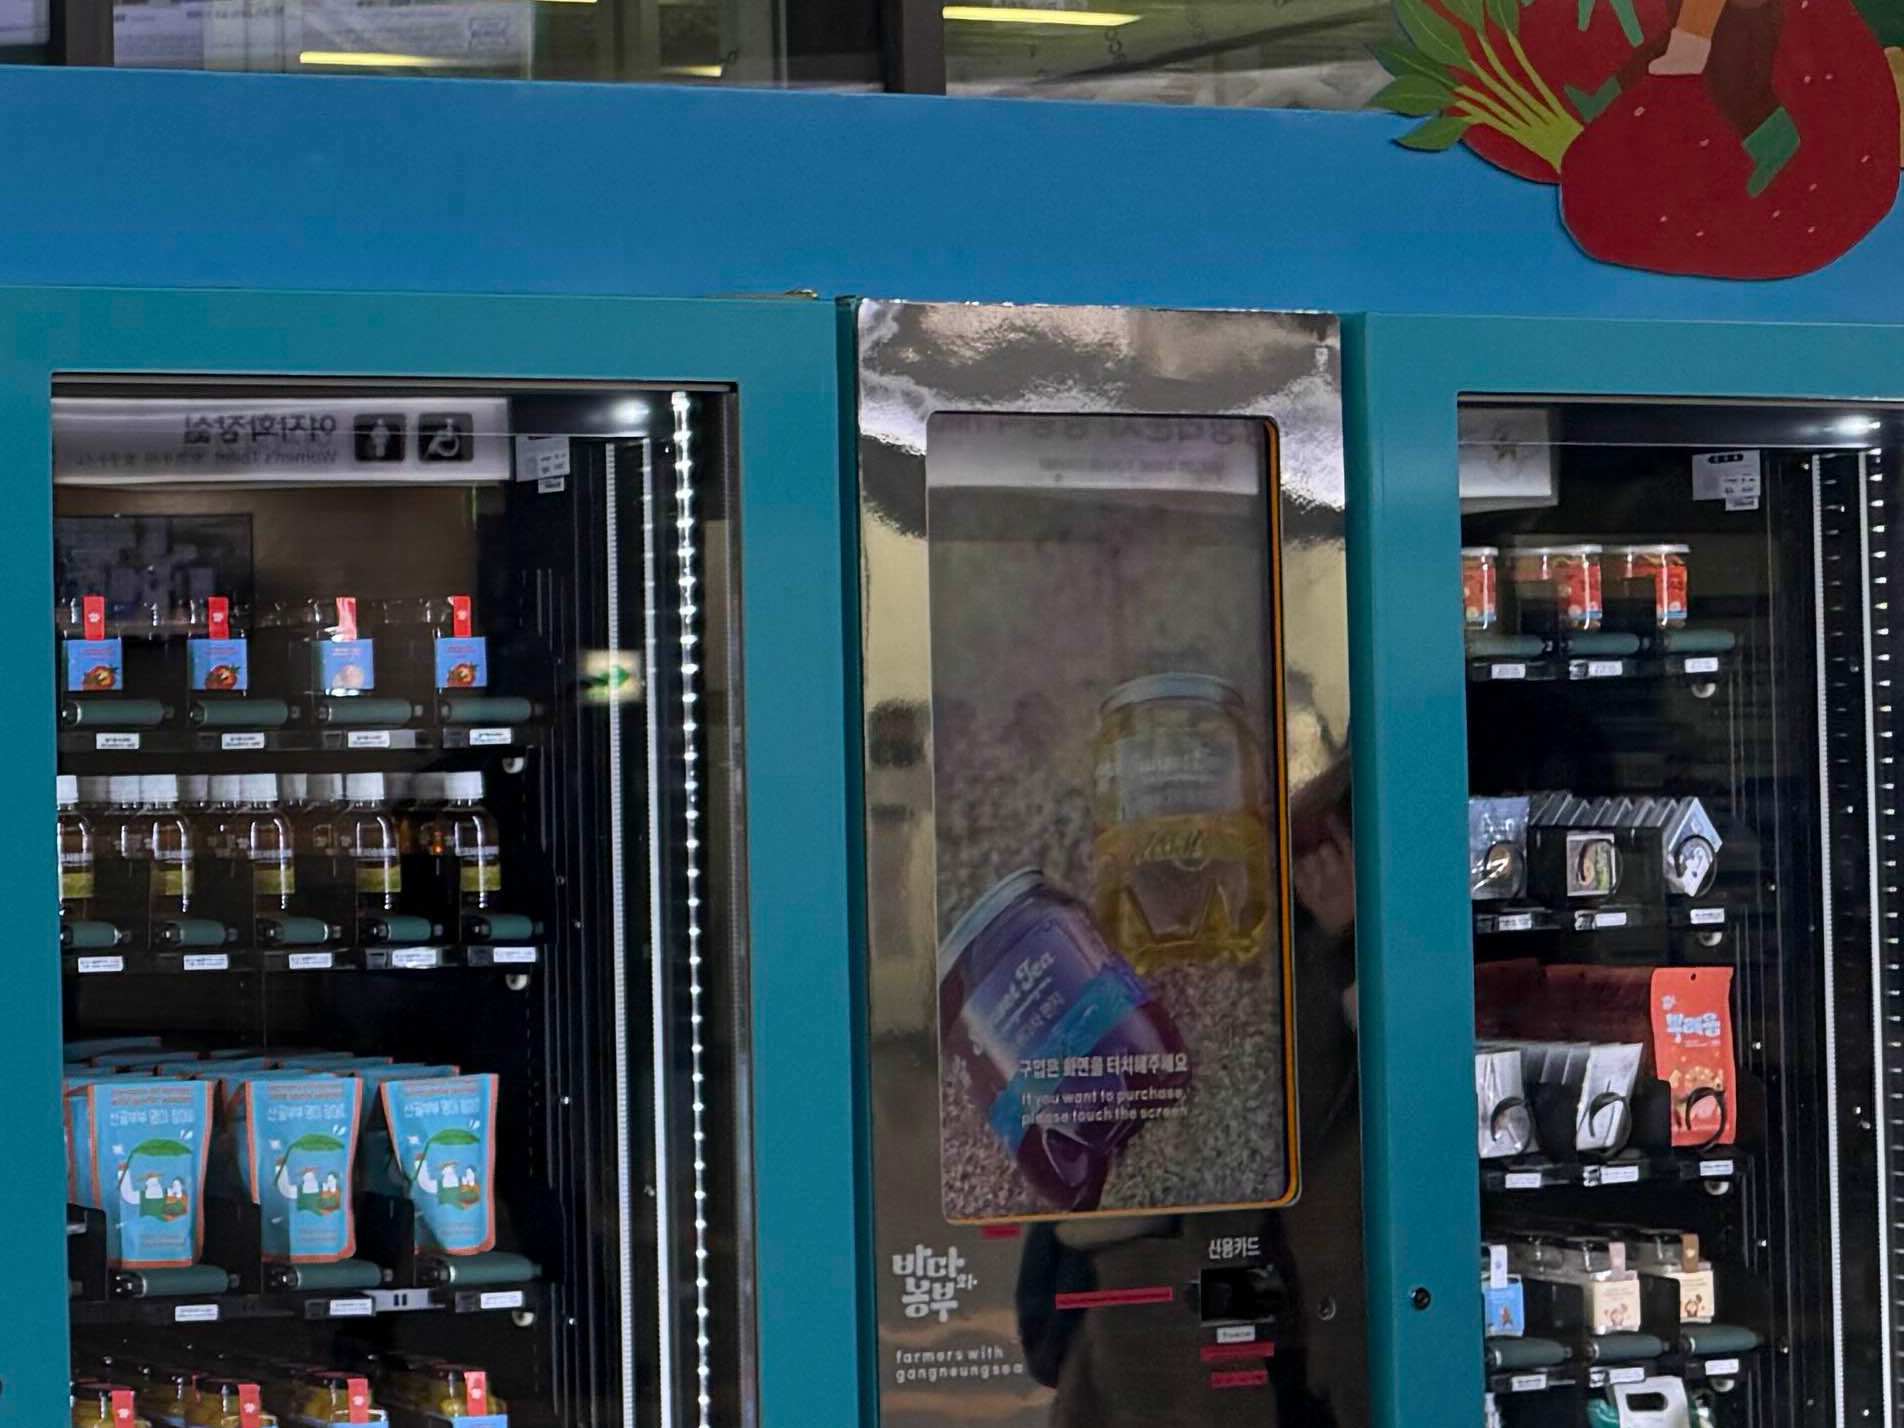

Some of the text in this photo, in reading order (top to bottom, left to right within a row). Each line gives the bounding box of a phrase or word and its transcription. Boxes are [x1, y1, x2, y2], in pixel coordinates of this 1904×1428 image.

[1062, 1089, 1097, 1104] want
[1100, 1088, 1116, 1103] to
[1073, 1107, 1113, 1122] touch
[1115, 1105, 1137, 1120] the
[1208, 1236, 1262, 1260] 신용카드
[895, 1344, 1004, 1364] farmers with
